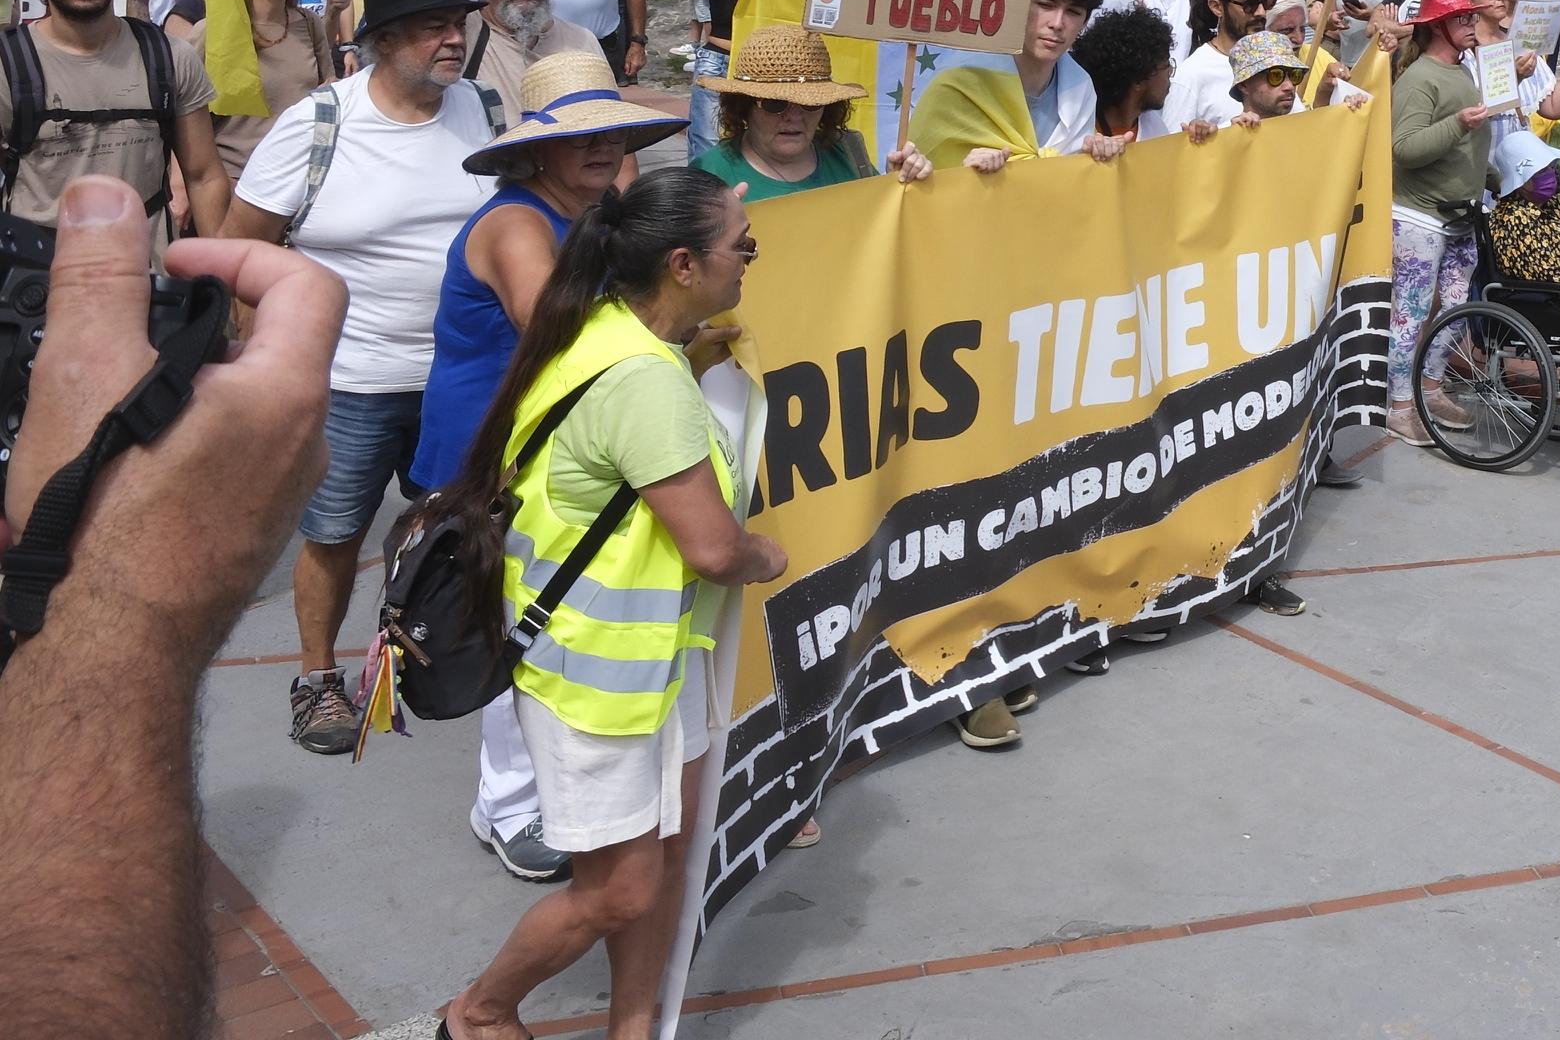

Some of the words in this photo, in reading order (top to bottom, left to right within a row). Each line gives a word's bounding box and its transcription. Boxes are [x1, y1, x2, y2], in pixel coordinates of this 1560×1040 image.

[1008, 261, 1210, 426] TIENE
[1236, 232, 1337, 356] UN
[888, 519, 965, 581] UN
[977, 450, 1157, 552] CAMBIO
[1159, 418, 1197, 479] DE
